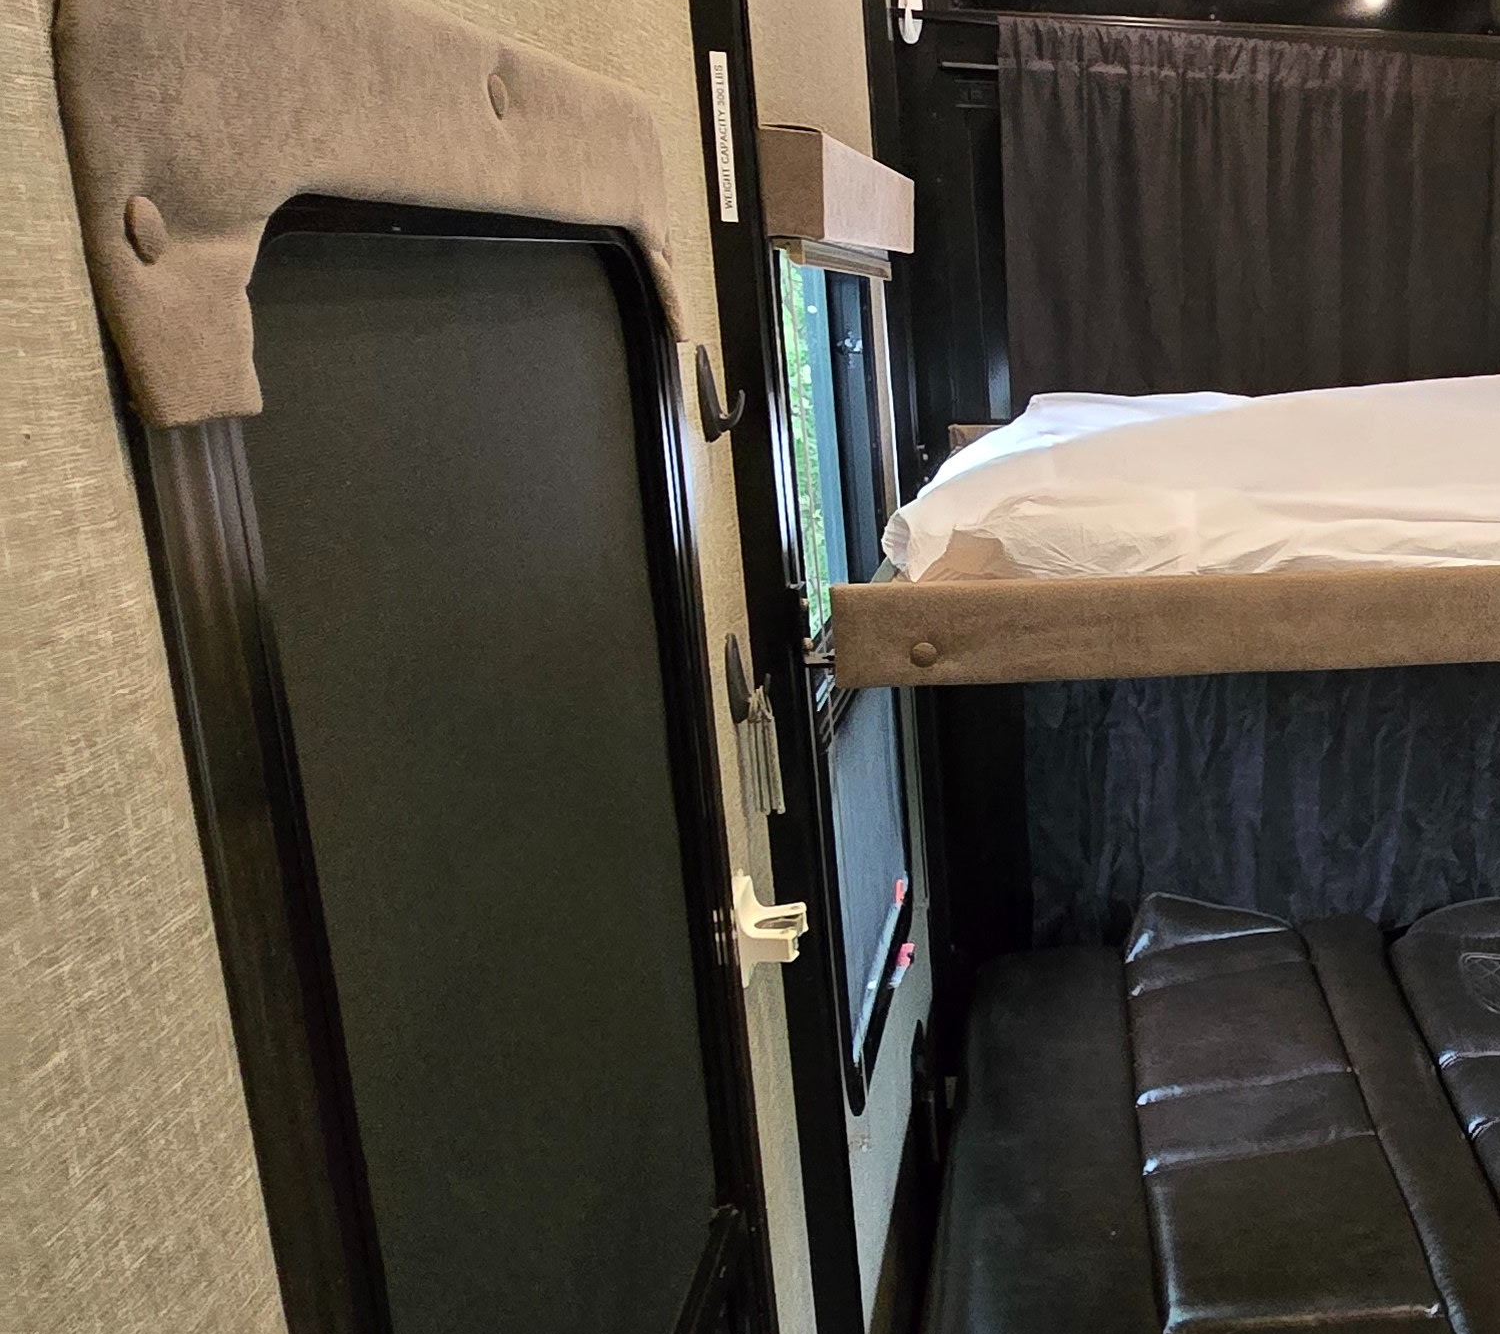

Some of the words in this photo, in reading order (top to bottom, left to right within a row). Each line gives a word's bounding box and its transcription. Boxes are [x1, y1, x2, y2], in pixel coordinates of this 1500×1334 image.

[715, 64, 724, 85] LBS
[717, 110, 730, 164] CAPACITY
[721, 169, 733, 209] WEIGHT
